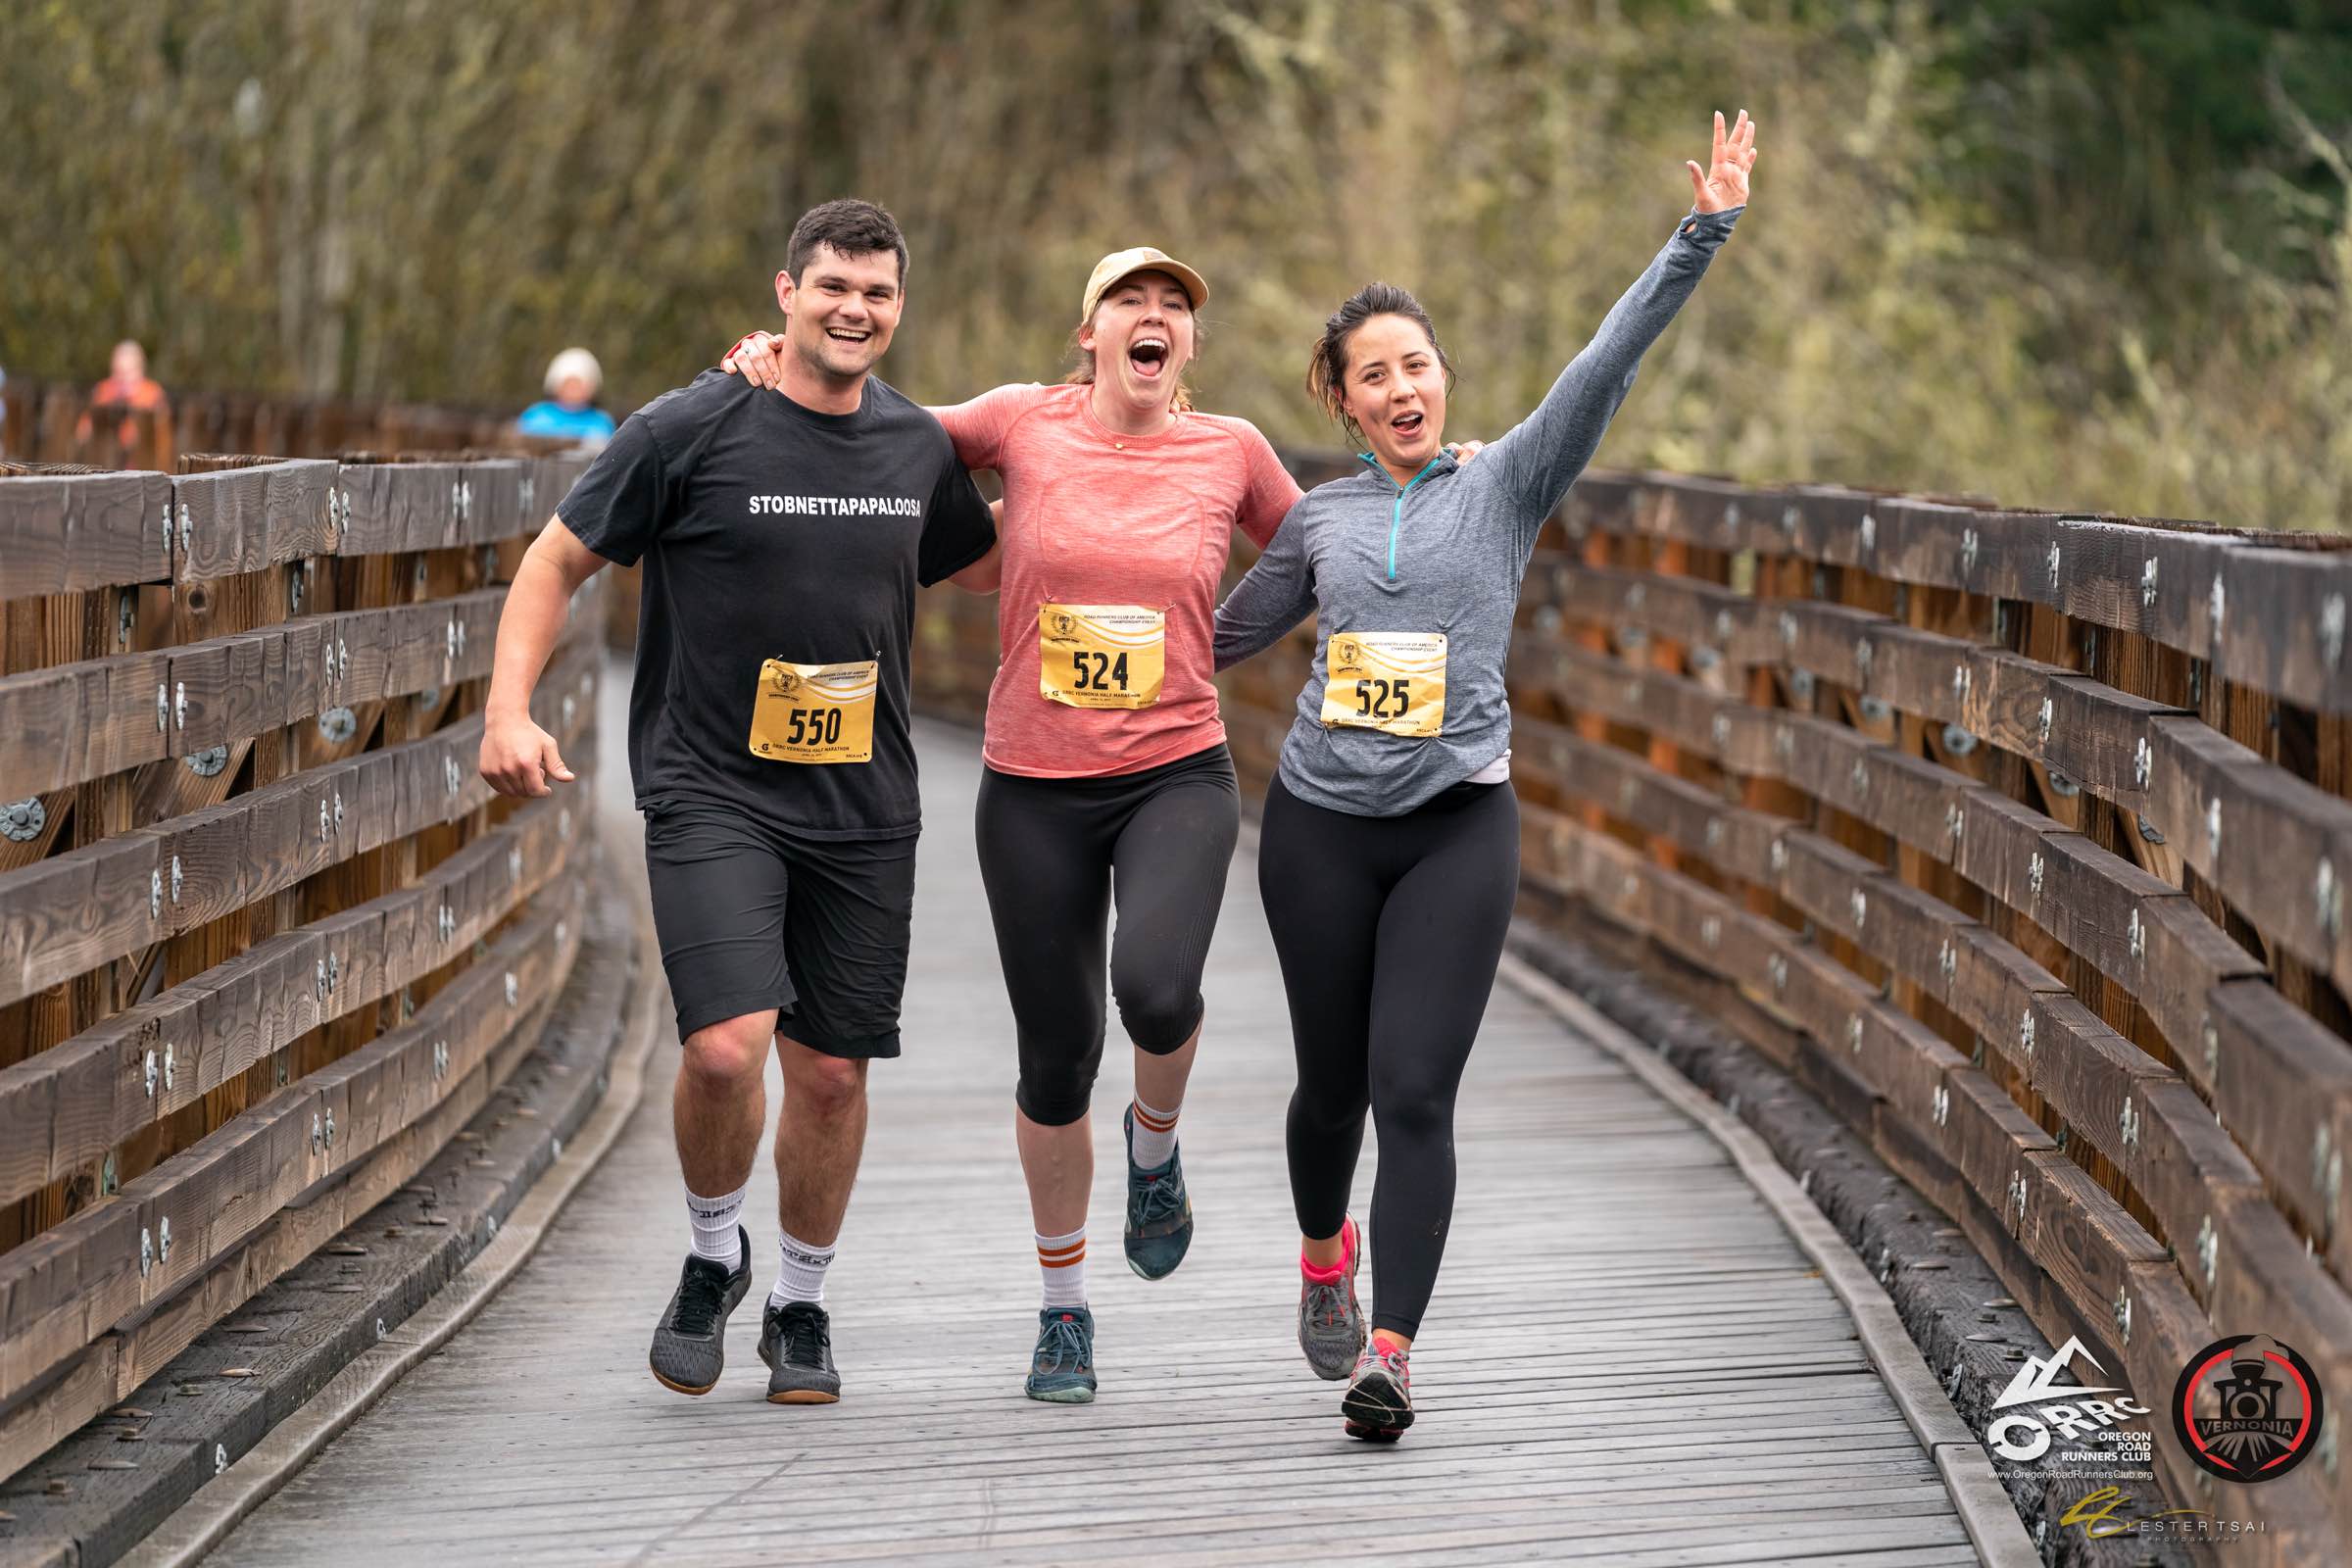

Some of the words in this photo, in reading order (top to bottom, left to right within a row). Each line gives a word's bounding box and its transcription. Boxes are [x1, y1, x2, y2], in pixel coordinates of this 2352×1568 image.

[749, 495, 921, 517] STOBNETTAPAPALOOSA
[1073, 652, 1128, 690] 524
[1355, 679, 1409, 718] 525
[786, 708, 842, 746] 550
